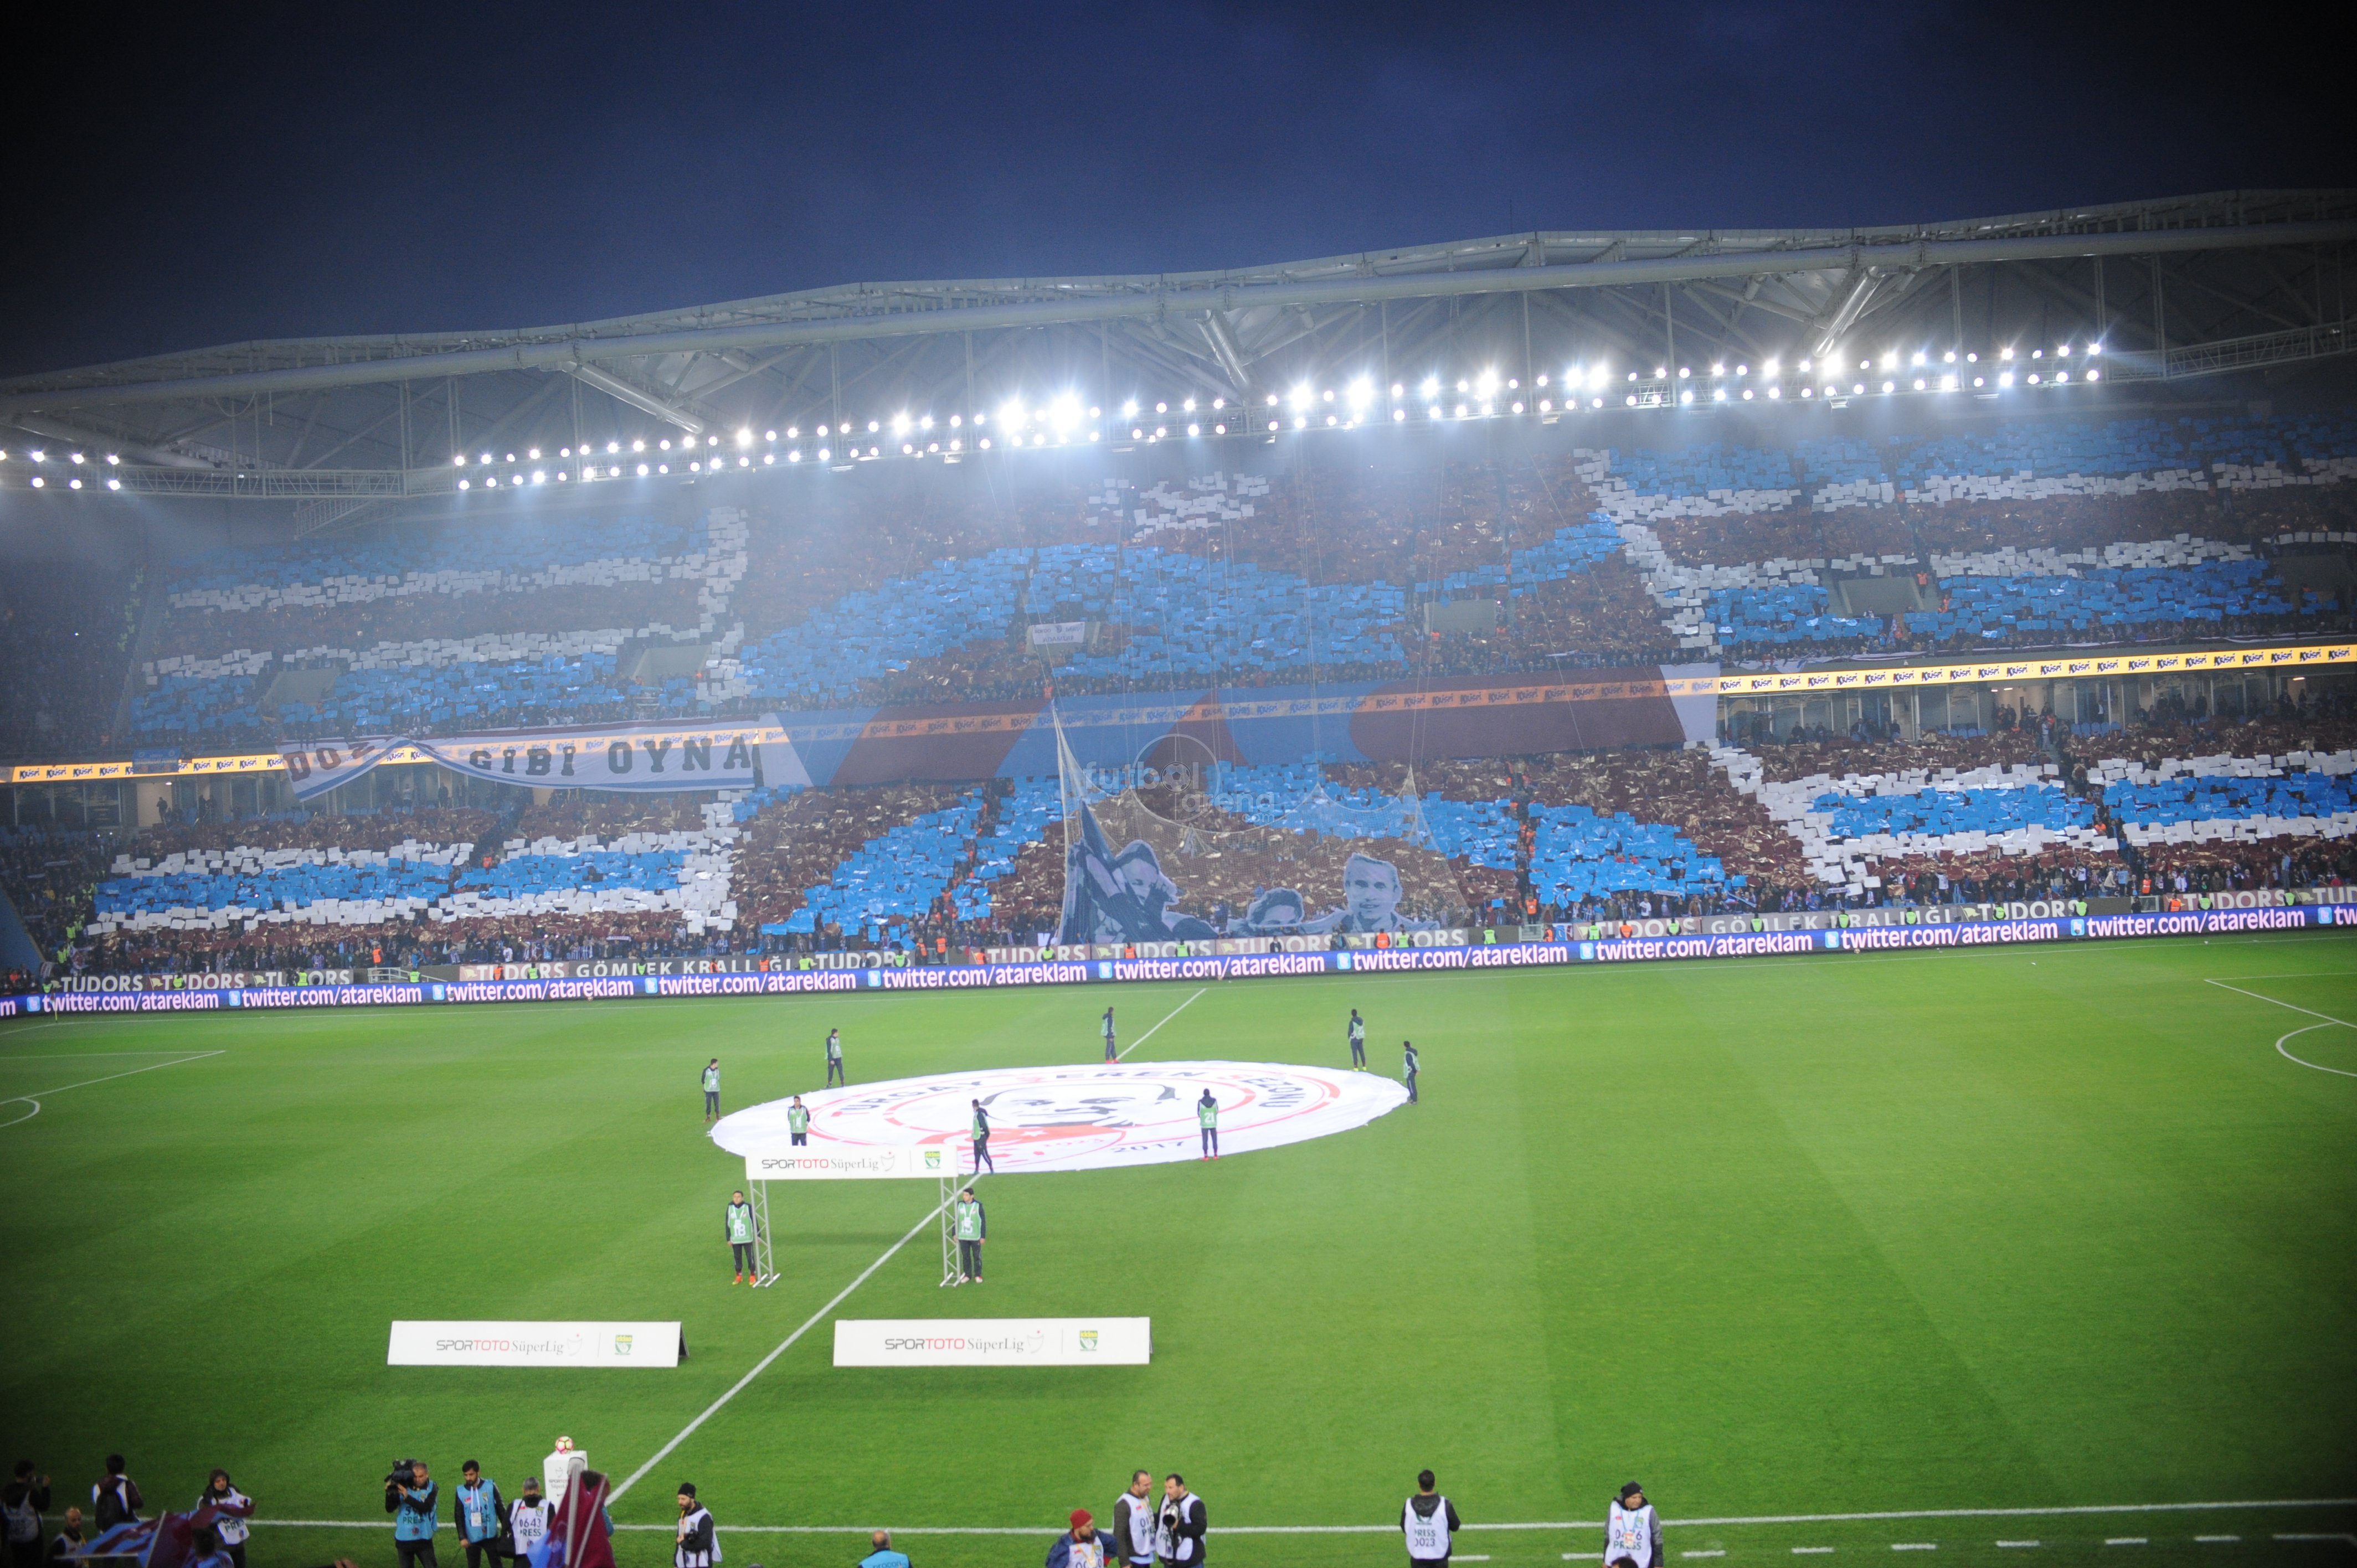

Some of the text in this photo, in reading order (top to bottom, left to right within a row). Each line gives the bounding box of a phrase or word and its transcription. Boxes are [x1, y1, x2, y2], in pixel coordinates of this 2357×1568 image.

[608, 736, 750, 774] OYNA
[1362, 931, 1464, 950] TORS
[43, 992, 219, 1012] twitter.com/atareklam
[242, 986, 423, 1007] twitter.com/atareklam
[446, 978, 634, 1002] twitter.com/atareklam
[660, 967, 857, 995] twitter.com/atareklam
[883, 957, 1088, 988] twitter.com/atareklam
[1114, 948, 1325, 980] twitter.com/atareklam
[1352, 938, 1568, 971] twitter.com/atareklam
[1596, 929, 1813, 961] twitter.com/atareklam
[1840, 919, 2058, 950] twitter.com/atareklam
[2087, 908, 2305, 938] twitter.com/atareklam
[683, 956, 790, 974] KRALLĞI
[61, 975, 143, 992] TUDORS
[266, 969, 350, 987] TORS
[1204, 1112, 1215, 1123] 21
[1110, 1141, 1184, 1153] 2017
